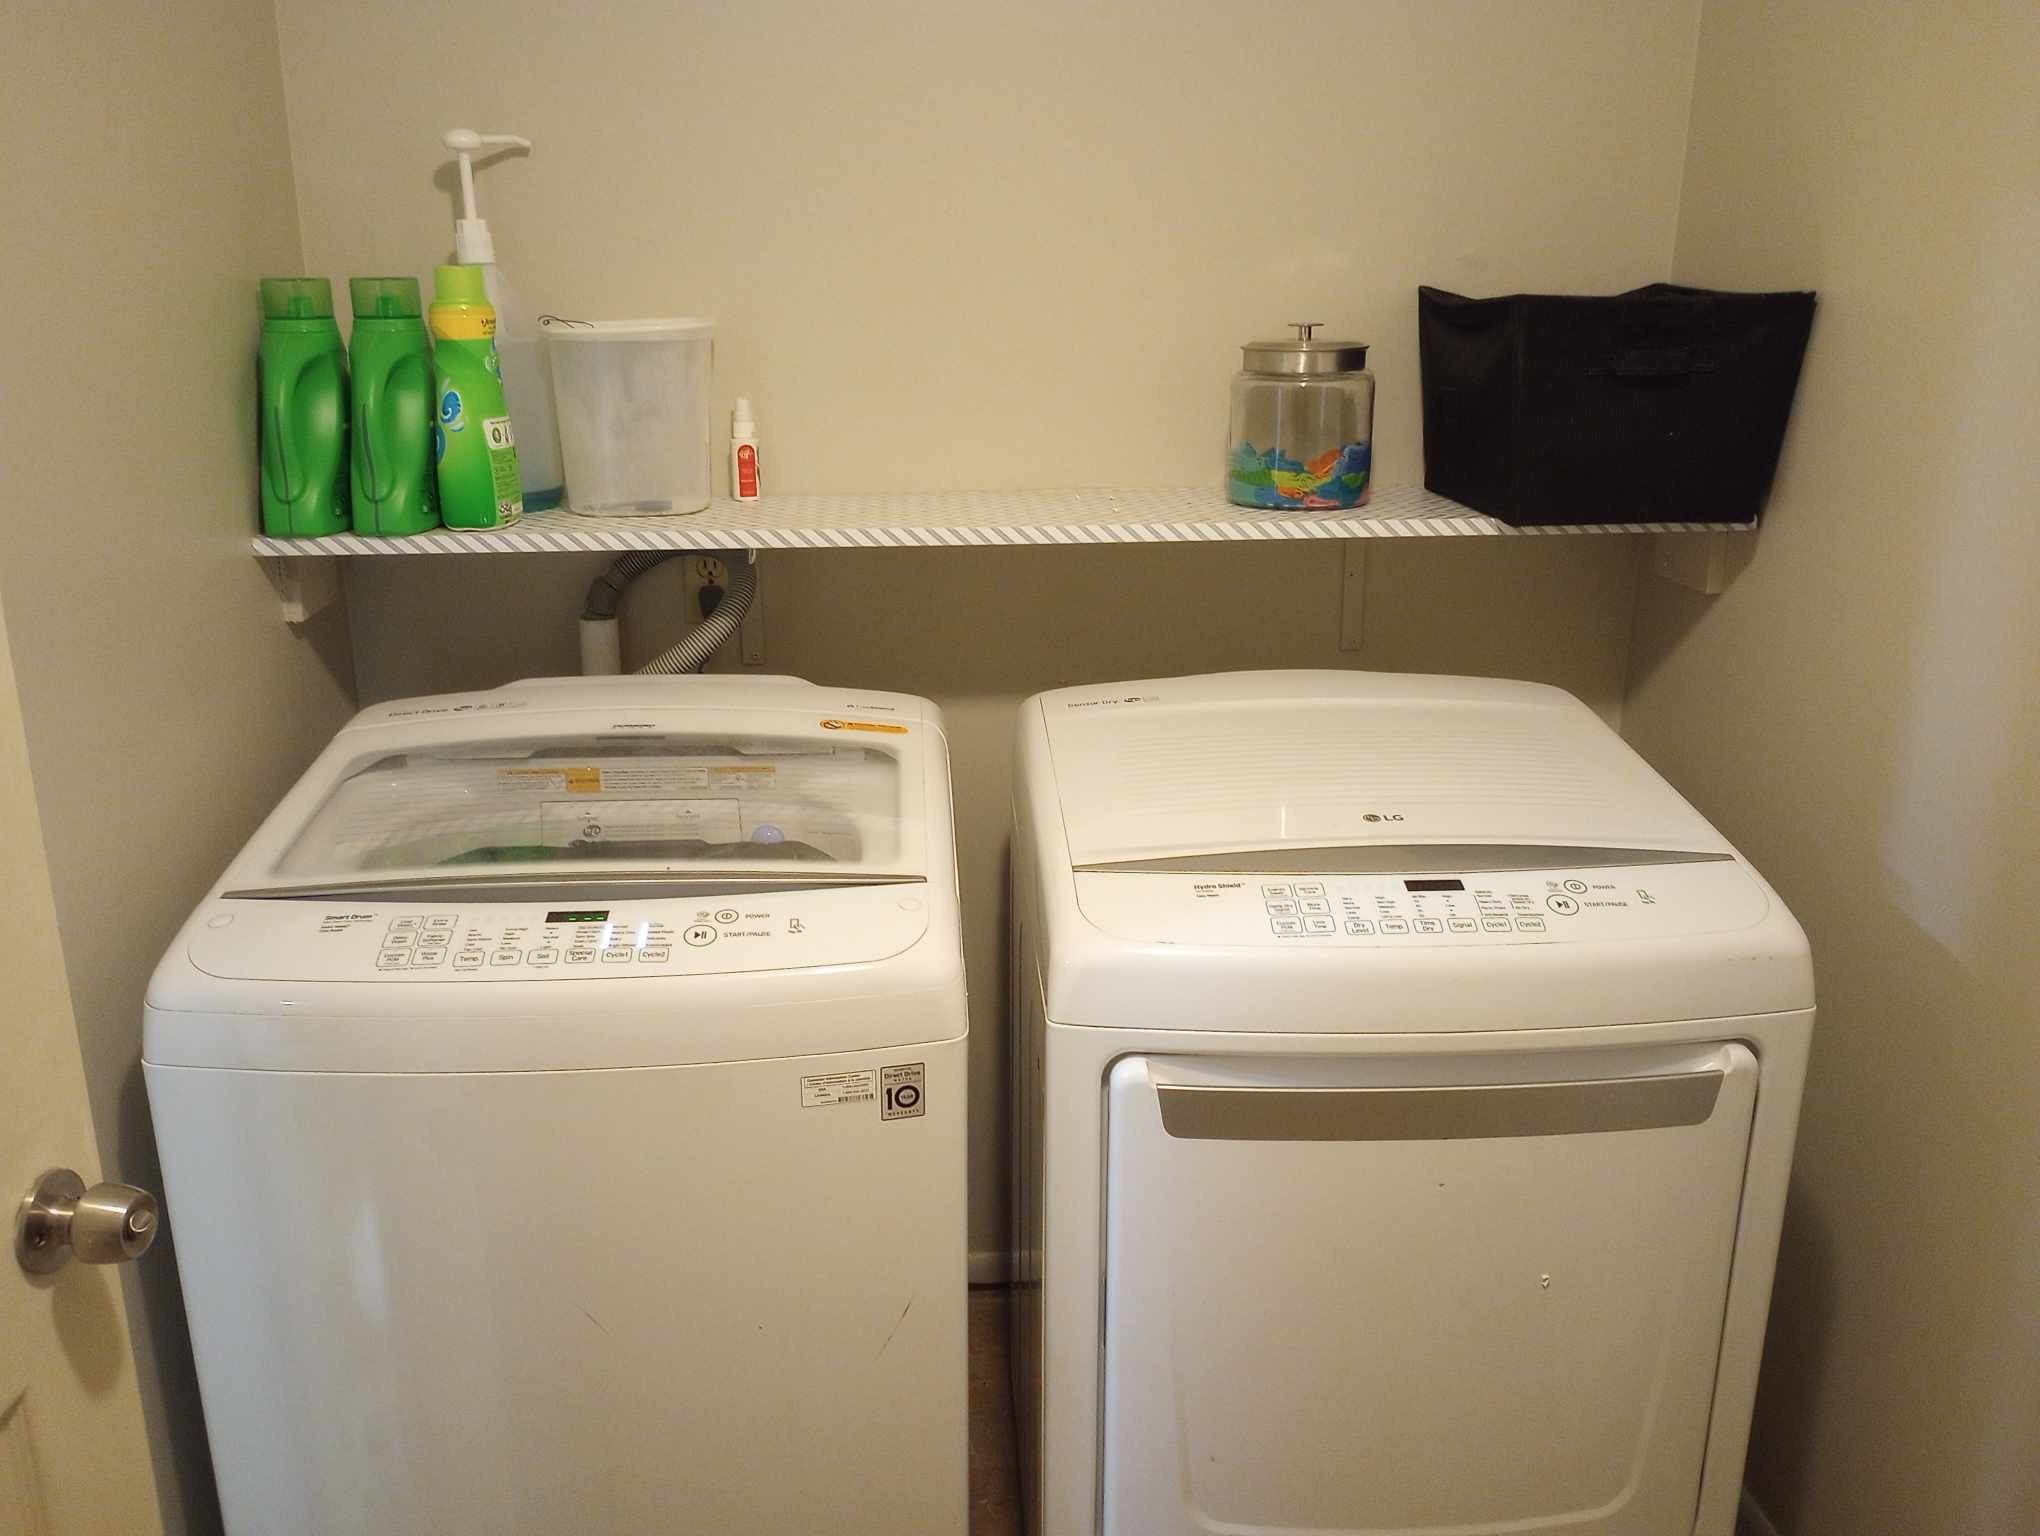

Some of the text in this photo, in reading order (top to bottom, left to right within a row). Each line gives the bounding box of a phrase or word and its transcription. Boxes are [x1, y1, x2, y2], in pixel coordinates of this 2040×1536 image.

[883, 1071, 904, 1080] Direct
[904, 1069, 921, 1078] Drive
[885, 1084, 921, 1110] 10
